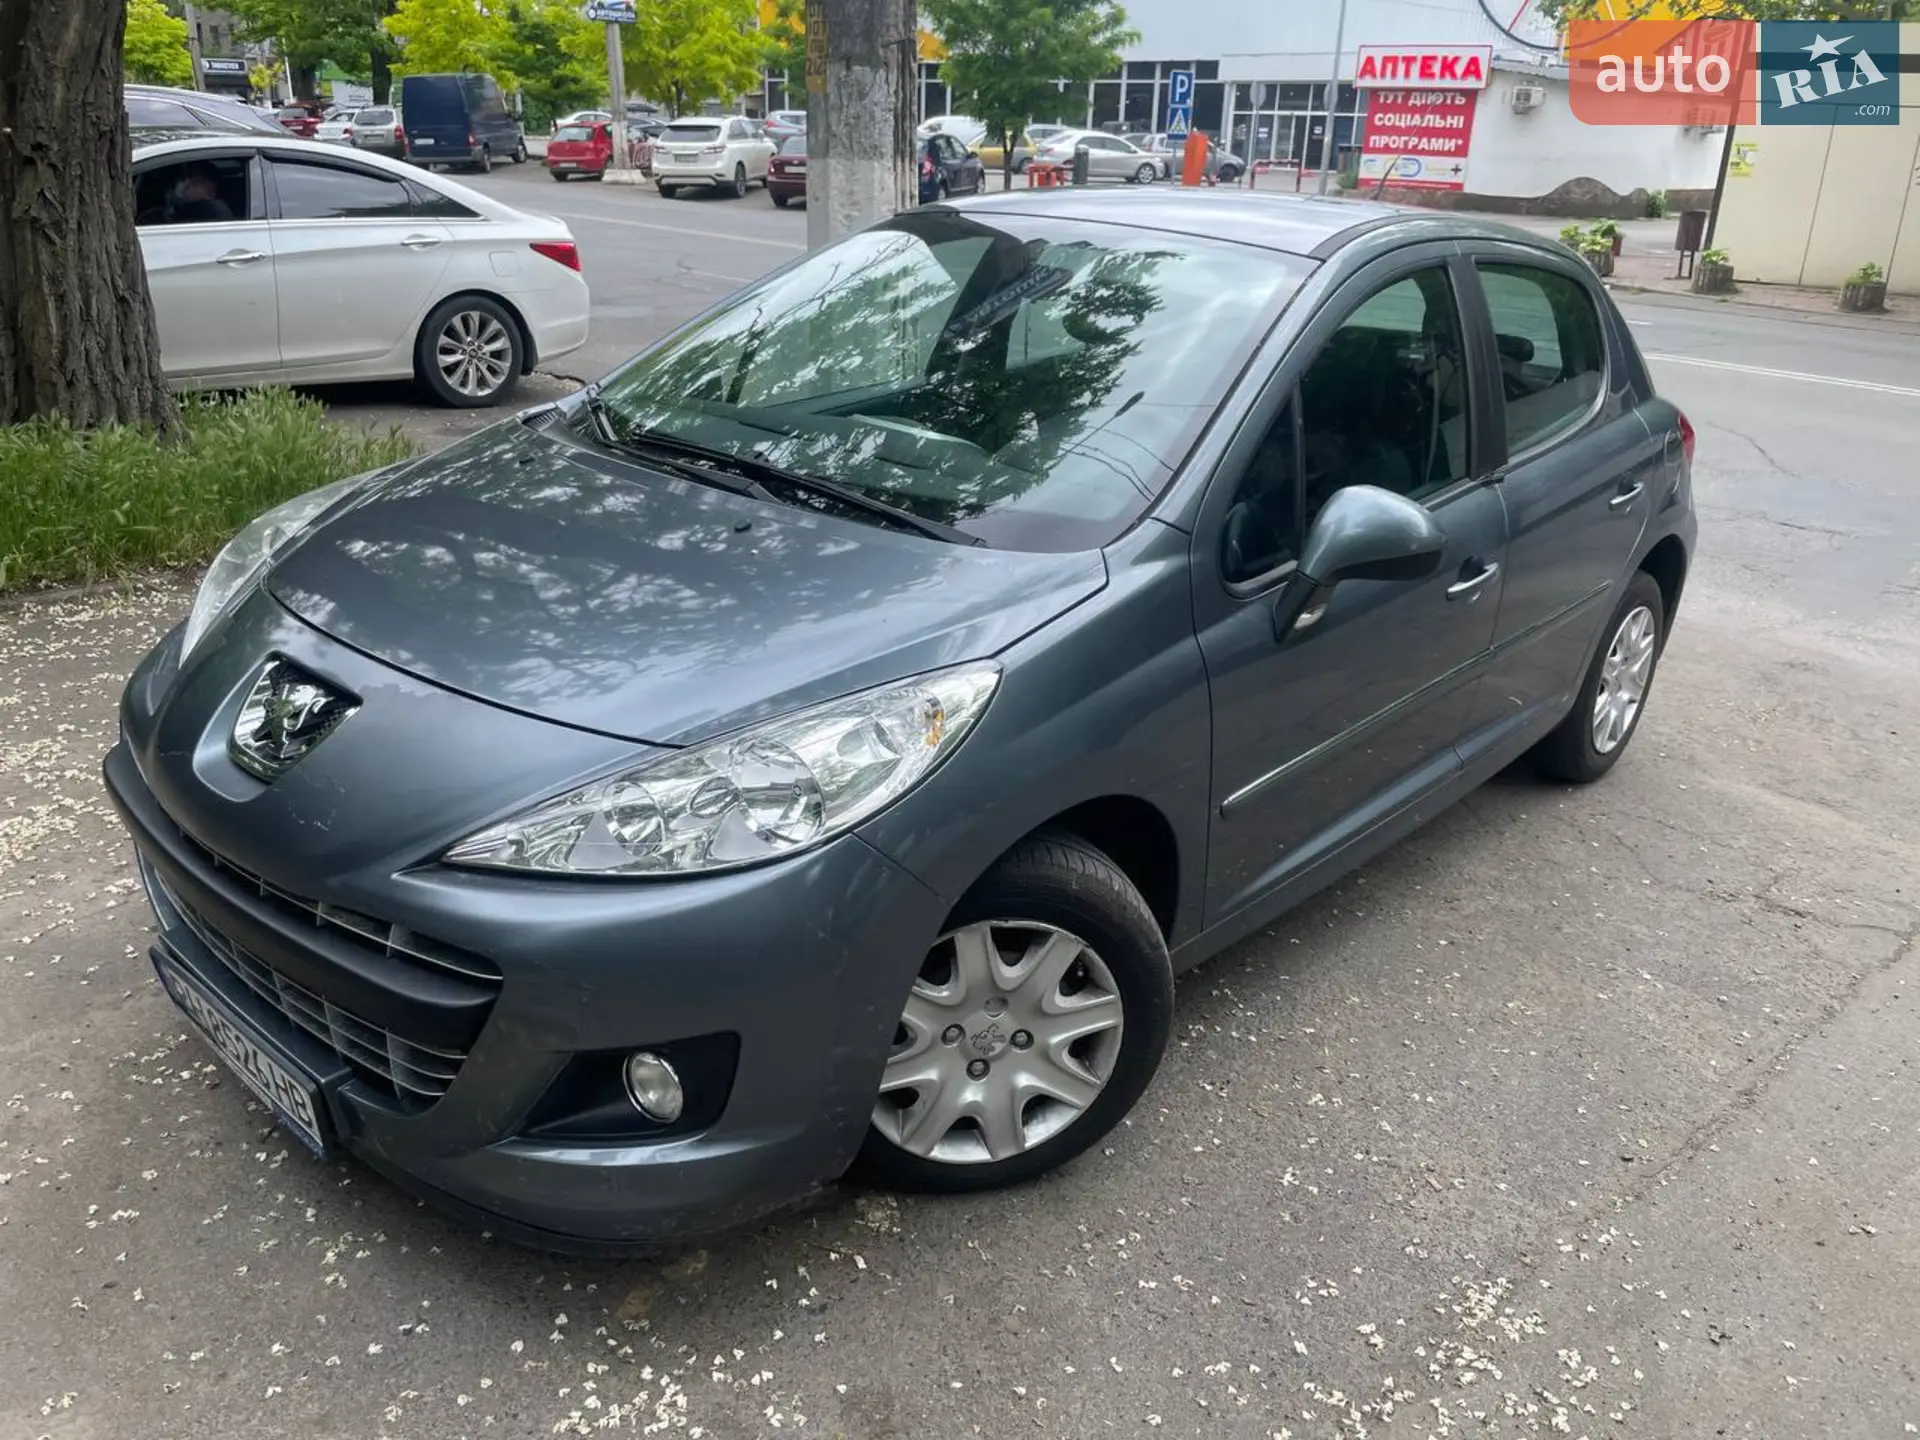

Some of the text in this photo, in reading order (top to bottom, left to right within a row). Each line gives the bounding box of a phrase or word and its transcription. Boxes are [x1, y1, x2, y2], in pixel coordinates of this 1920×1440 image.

[1359, 56, 1482, 81] АПТЕКА
[1175, 74, 1189, 102] P
[1377, 91, 1466, 106] ТУТ ДІЮТЬ
[1373, 113, 1465, 129] СОЦІАЛЬНІ
